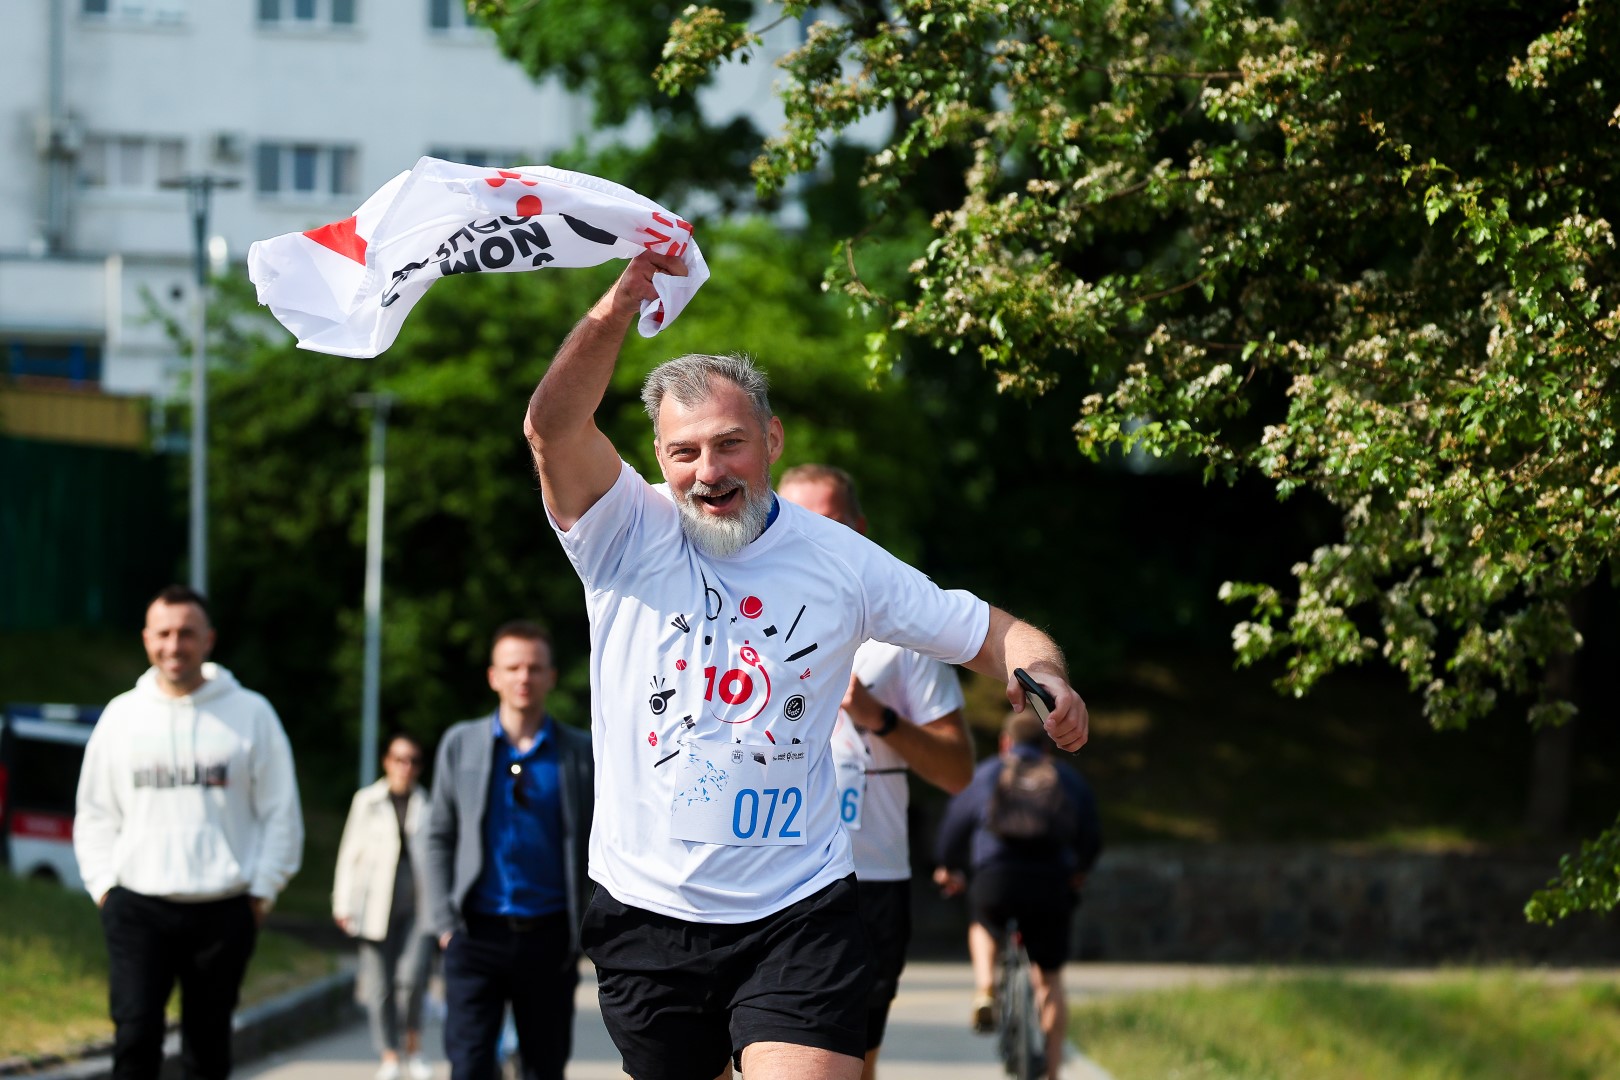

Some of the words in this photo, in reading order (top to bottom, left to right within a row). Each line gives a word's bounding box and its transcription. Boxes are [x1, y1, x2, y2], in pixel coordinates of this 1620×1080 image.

[704, 665, 753, 705] 10
[732, 787, 802, 839] 072
[841, 788, 858, 823] 6
